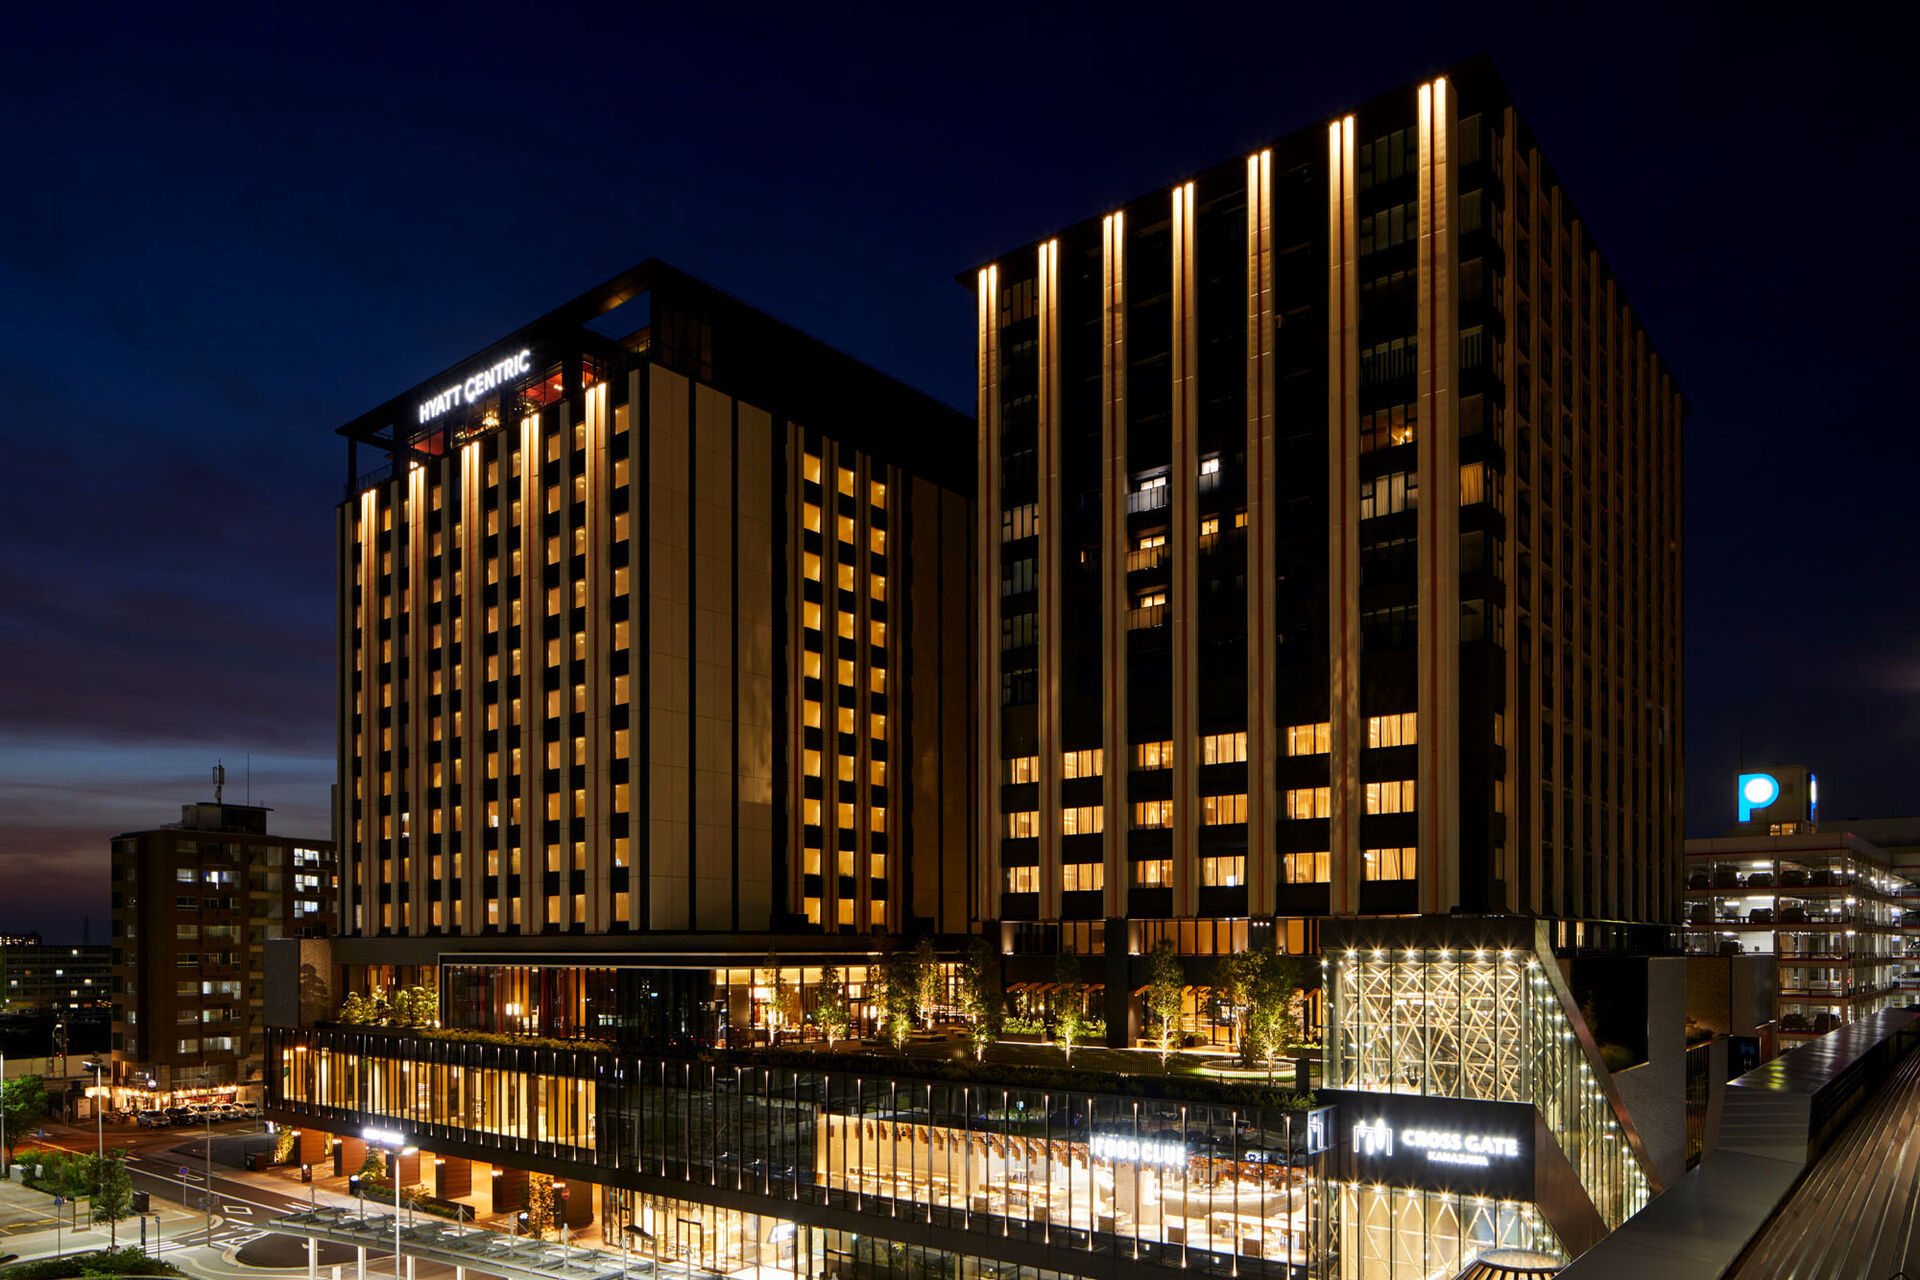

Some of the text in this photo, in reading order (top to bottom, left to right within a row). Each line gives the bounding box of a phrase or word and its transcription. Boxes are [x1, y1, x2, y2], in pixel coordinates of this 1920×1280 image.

[419, 349, 530, 424] HYATT CENTRIC
[1738, 773, 1780, 822] P
[1092, 1136, 1139, 1160] FOOD
[1402, 1129, 1518, 1156] CROSS GATE
